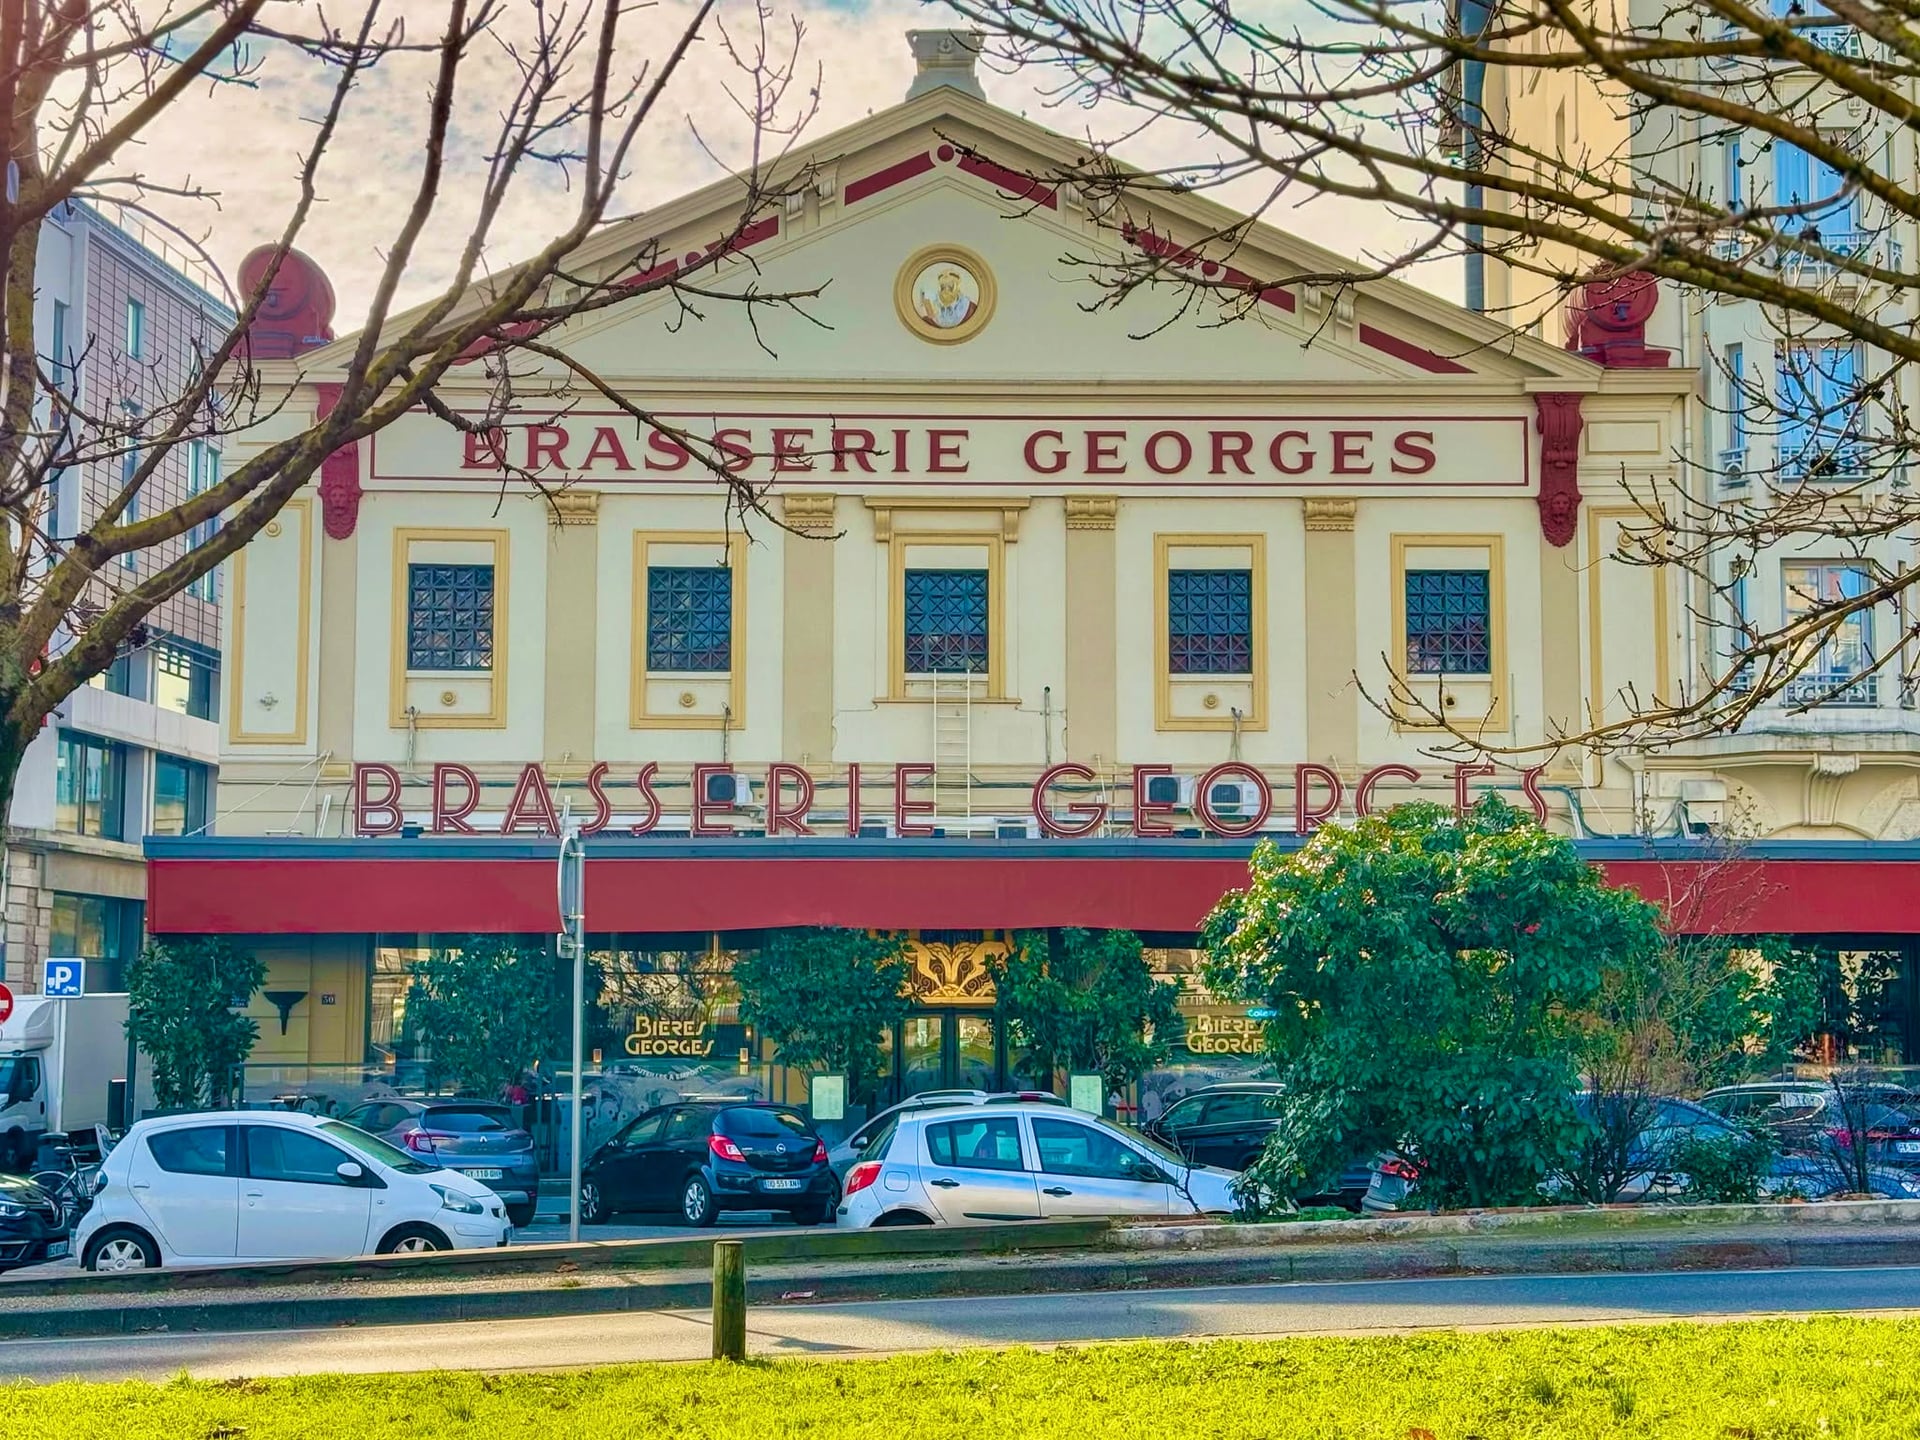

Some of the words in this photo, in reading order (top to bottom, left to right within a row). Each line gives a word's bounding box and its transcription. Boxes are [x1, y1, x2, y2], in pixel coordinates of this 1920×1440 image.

[460, 426, 970, 473] BRASSERIE
[1023, 430, 1437, 475] GEORGES
[354, 761, 935, 835] BRASSERIE
[55, 966, 72, 990] P
[625, 1034, 715, 1057] GEORGES
[1187, 1033, 1266, 1054] GEORGE
